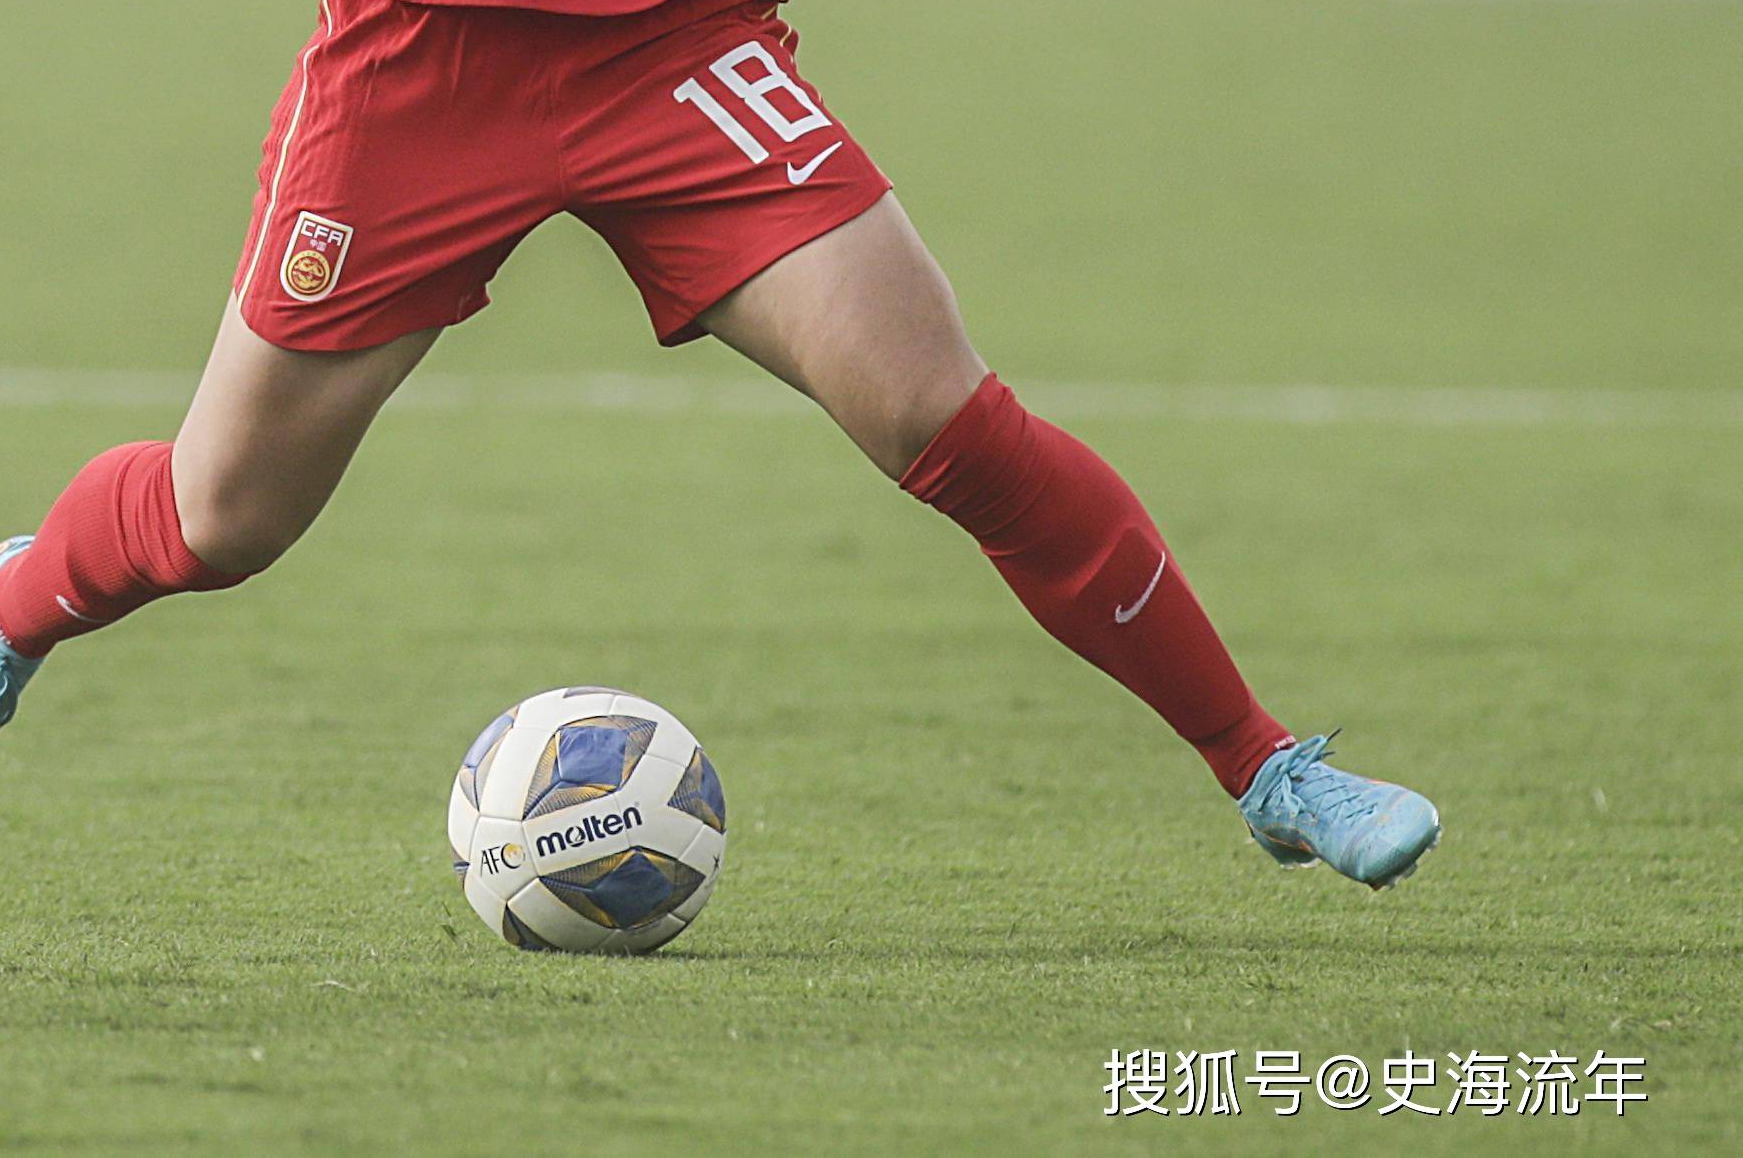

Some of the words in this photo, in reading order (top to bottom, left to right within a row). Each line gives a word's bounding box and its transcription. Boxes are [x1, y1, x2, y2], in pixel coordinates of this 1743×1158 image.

[673, 41, 832, 164] 18
[301, 220, 344, 246] CFA
[536, 807, 642, 857] molten
[480, 842, 525, 877] AFC
